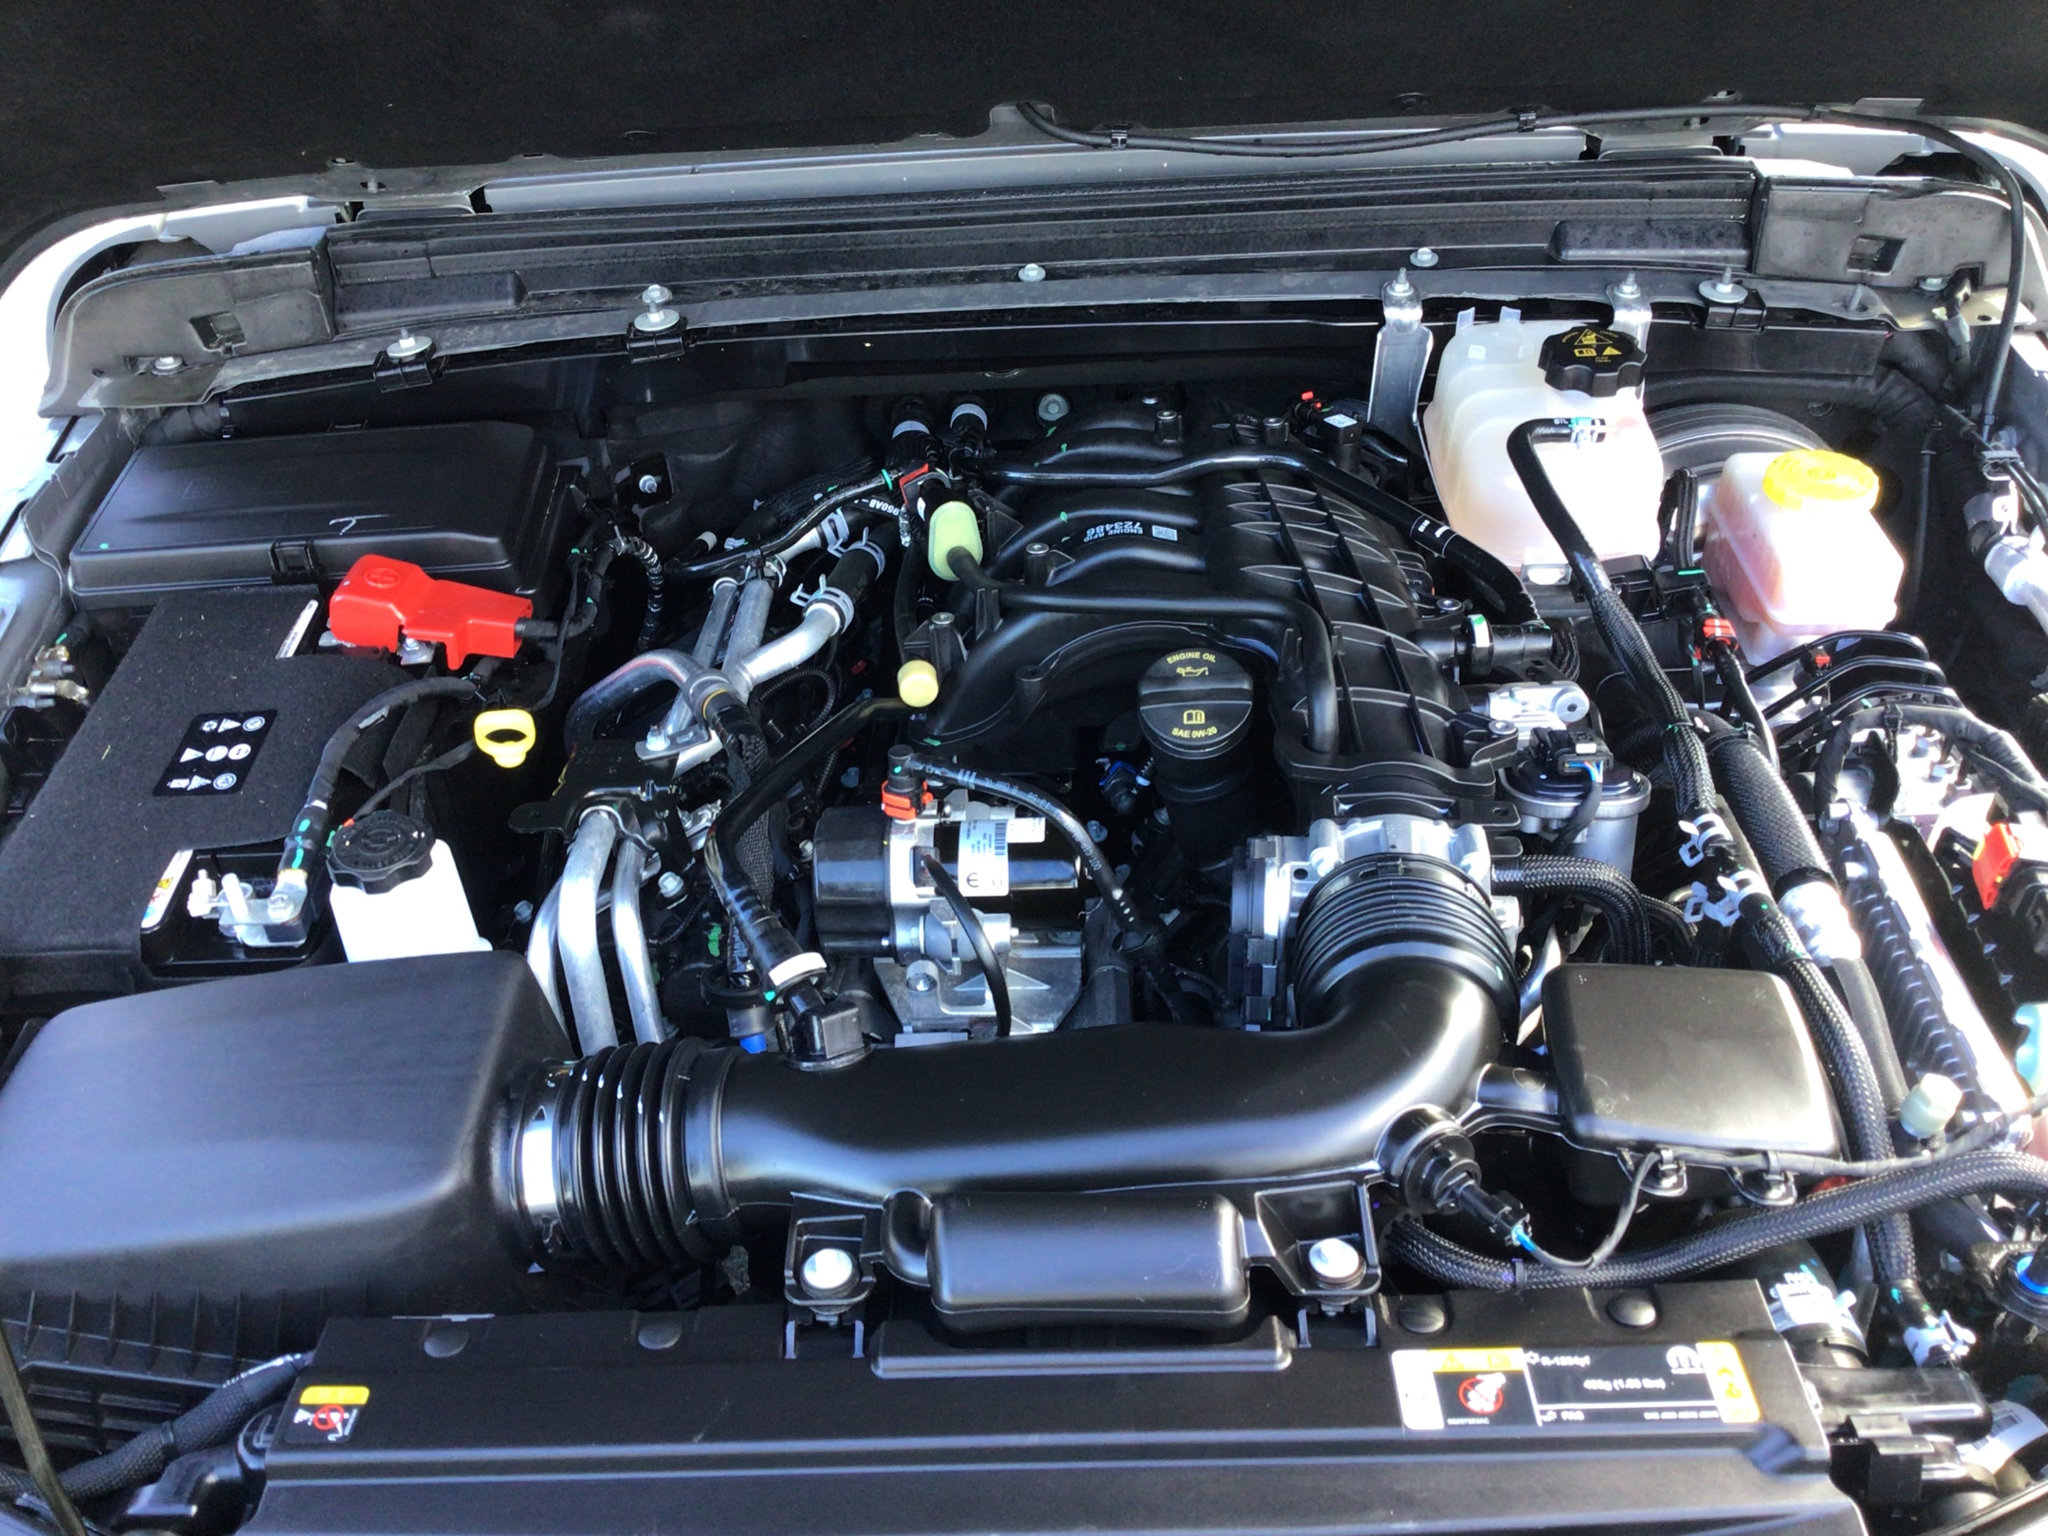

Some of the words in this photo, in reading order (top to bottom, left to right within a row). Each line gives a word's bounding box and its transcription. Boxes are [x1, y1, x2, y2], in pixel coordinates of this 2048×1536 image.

[1107, 527, 1143, 535] ENGINE
[1166, 652, 1200, 664] ENGINE
[1202, 652, 1216, 663] OIL
[1171, 727, 1190, 738] SAE
[1191, 727, 1218, 738] 0W-20
